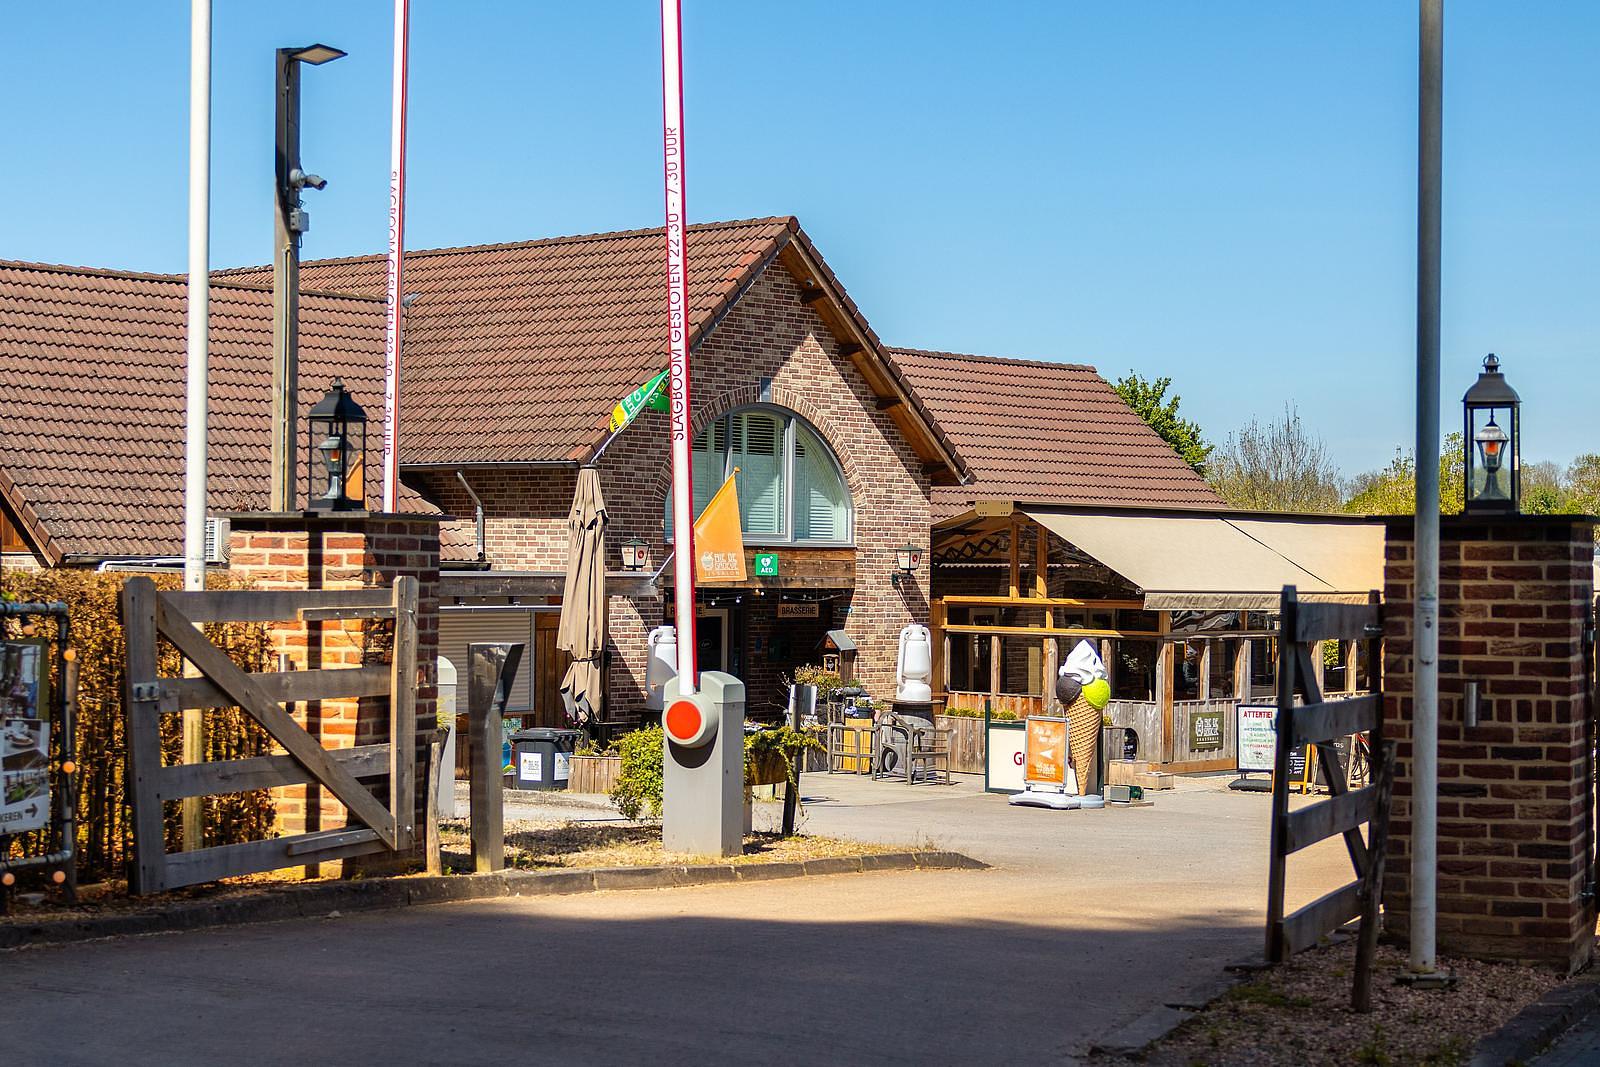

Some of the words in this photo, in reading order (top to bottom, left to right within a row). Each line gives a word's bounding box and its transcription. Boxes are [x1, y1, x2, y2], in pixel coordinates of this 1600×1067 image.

[666, 127, 678, 156] UUR
[668, 213, 680, 258] 22.30
[672, 348, 684, 441] SLAGBOOM
[781, 606, 816, 615] BRASSERIE
